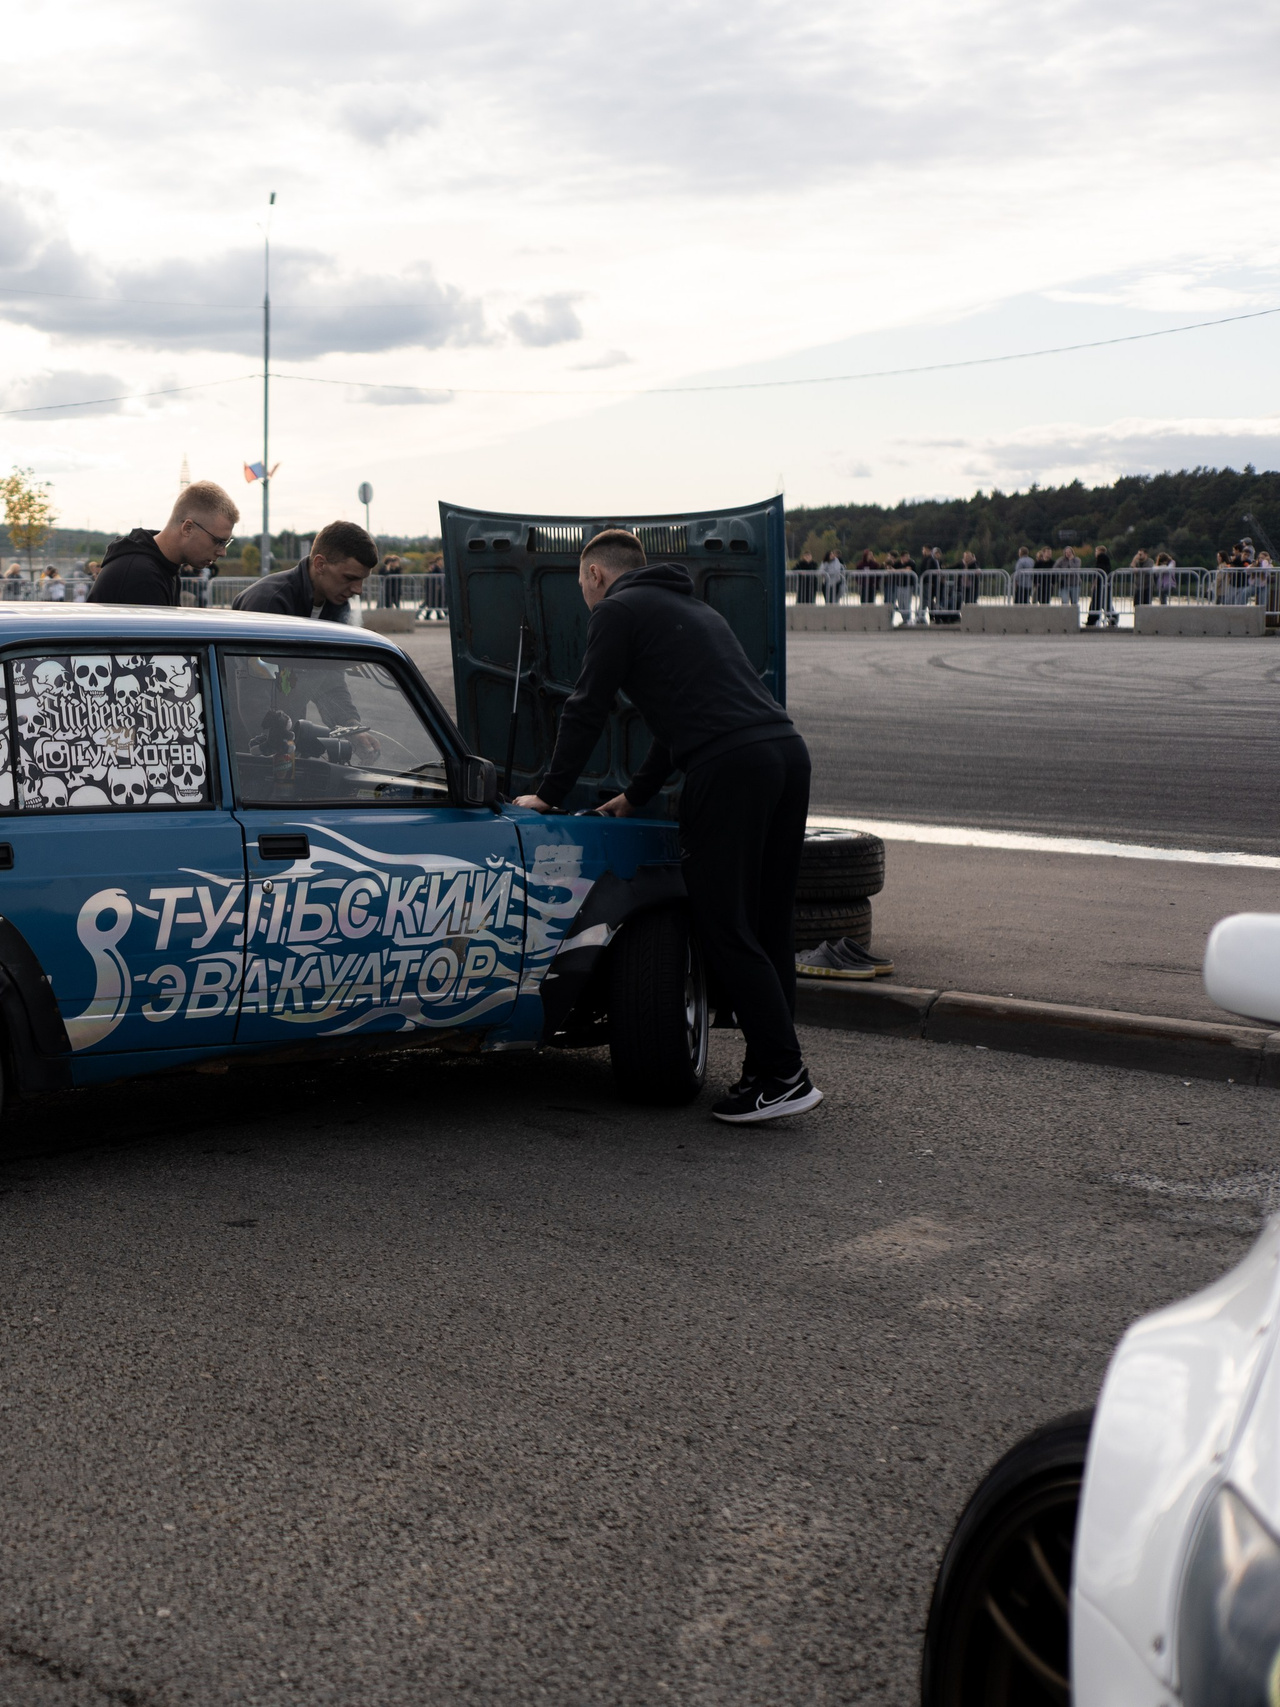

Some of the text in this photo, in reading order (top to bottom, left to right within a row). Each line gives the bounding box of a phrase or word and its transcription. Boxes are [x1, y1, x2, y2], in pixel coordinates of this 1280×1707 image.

[36, 692, 136, 737] Stickers
[148, 853, 514, 951] ТУЛЬСКИЙ
[140, 946, 498, 1024] ЭВАКУАТОР
